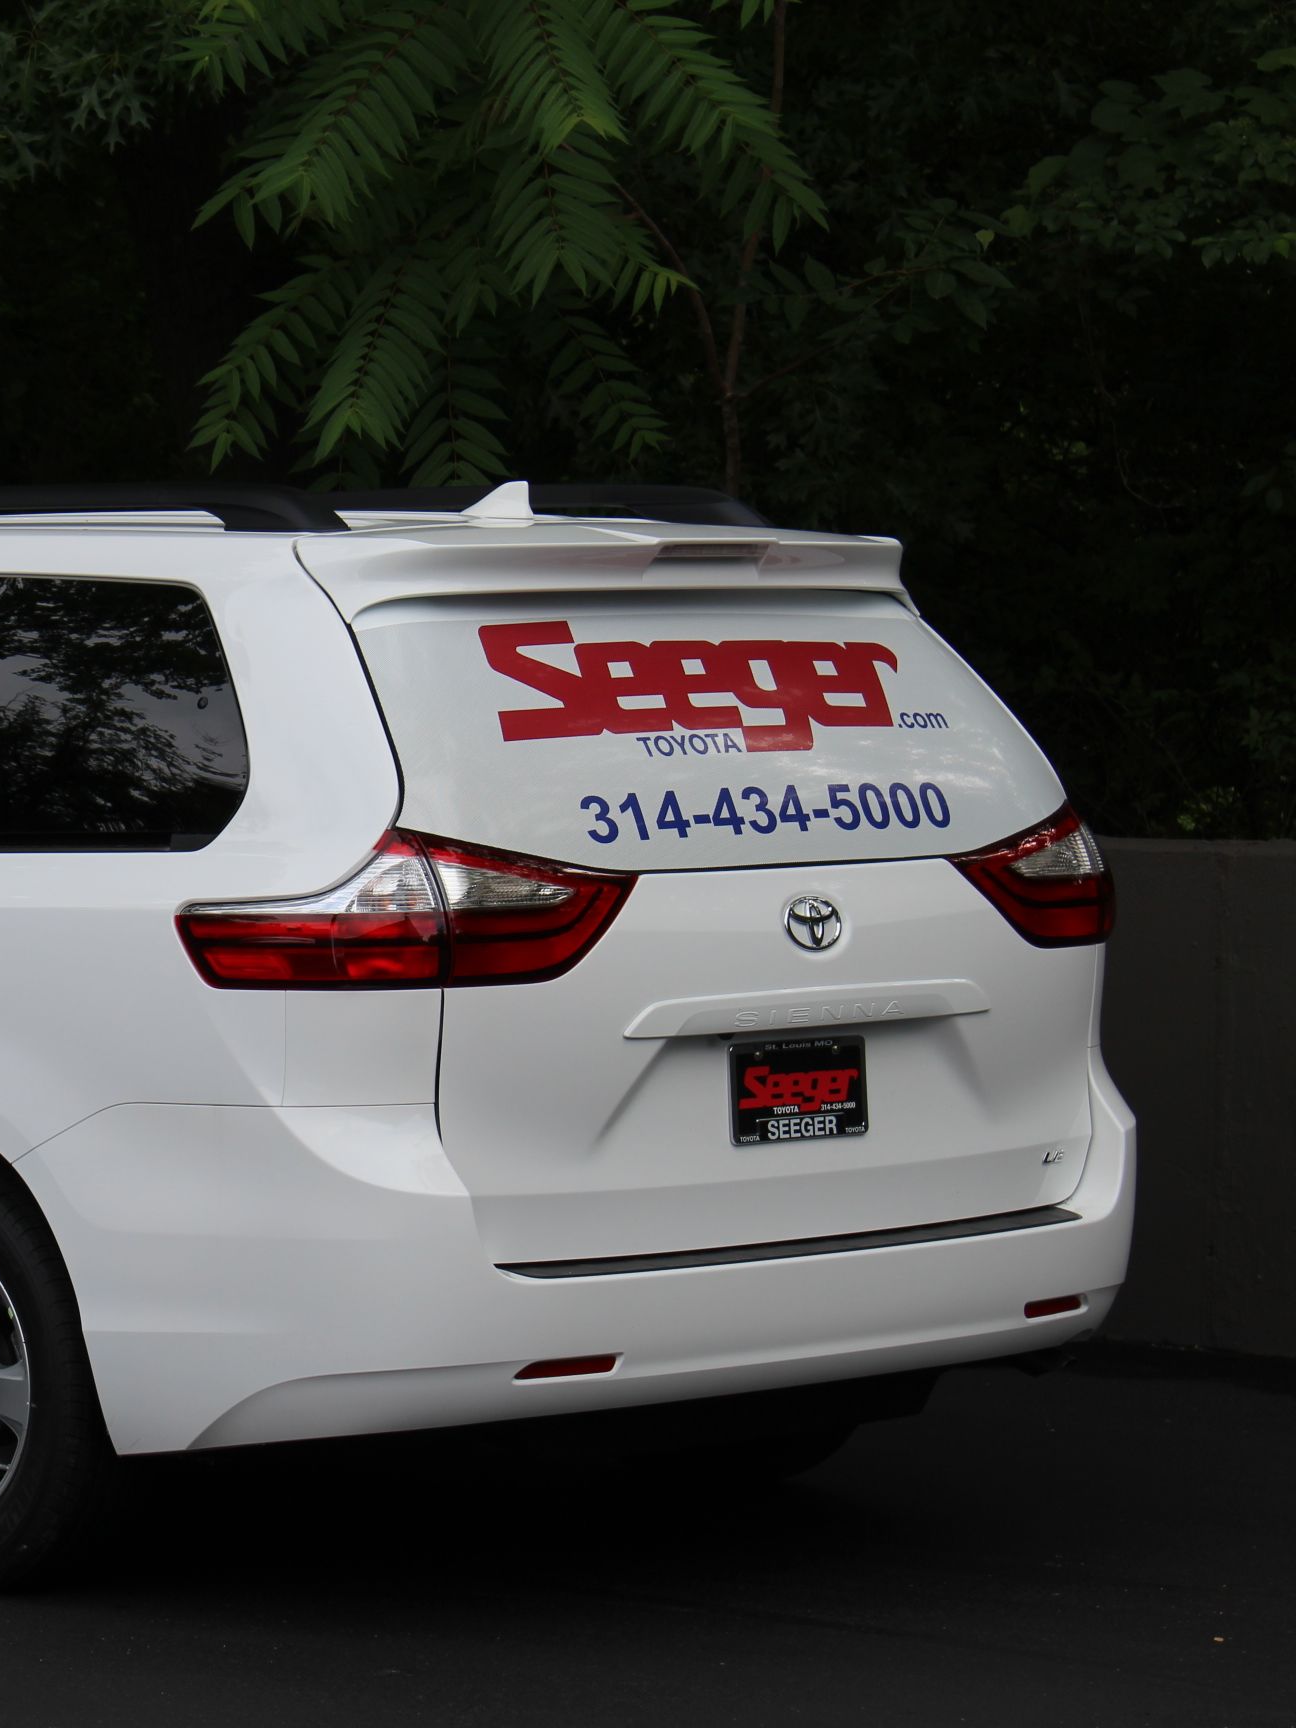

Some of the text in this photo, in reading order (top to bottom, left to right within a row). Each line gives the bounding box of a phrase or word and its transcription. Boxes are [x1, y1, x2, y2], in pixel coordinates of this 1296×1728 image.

[477, 620, 898, 753] Seeger
[636, 733, 742, 758] TOYOTA
[580, 782, 951, 844] 314-434-5000
[734, 1000, 905, 1028] SIENNA
[814, 1039, 834, 1047] MO
[739, 1066, 859, 1112] Seeger
[772, 1101, 856, 1115] TOYOTA 314-434-5000
[739, 1135, 761, 1143] TOYOTA
[767, 1115, 838, 1140] SEEGER
[845, 1126, 865, 1134] TOYOTA
